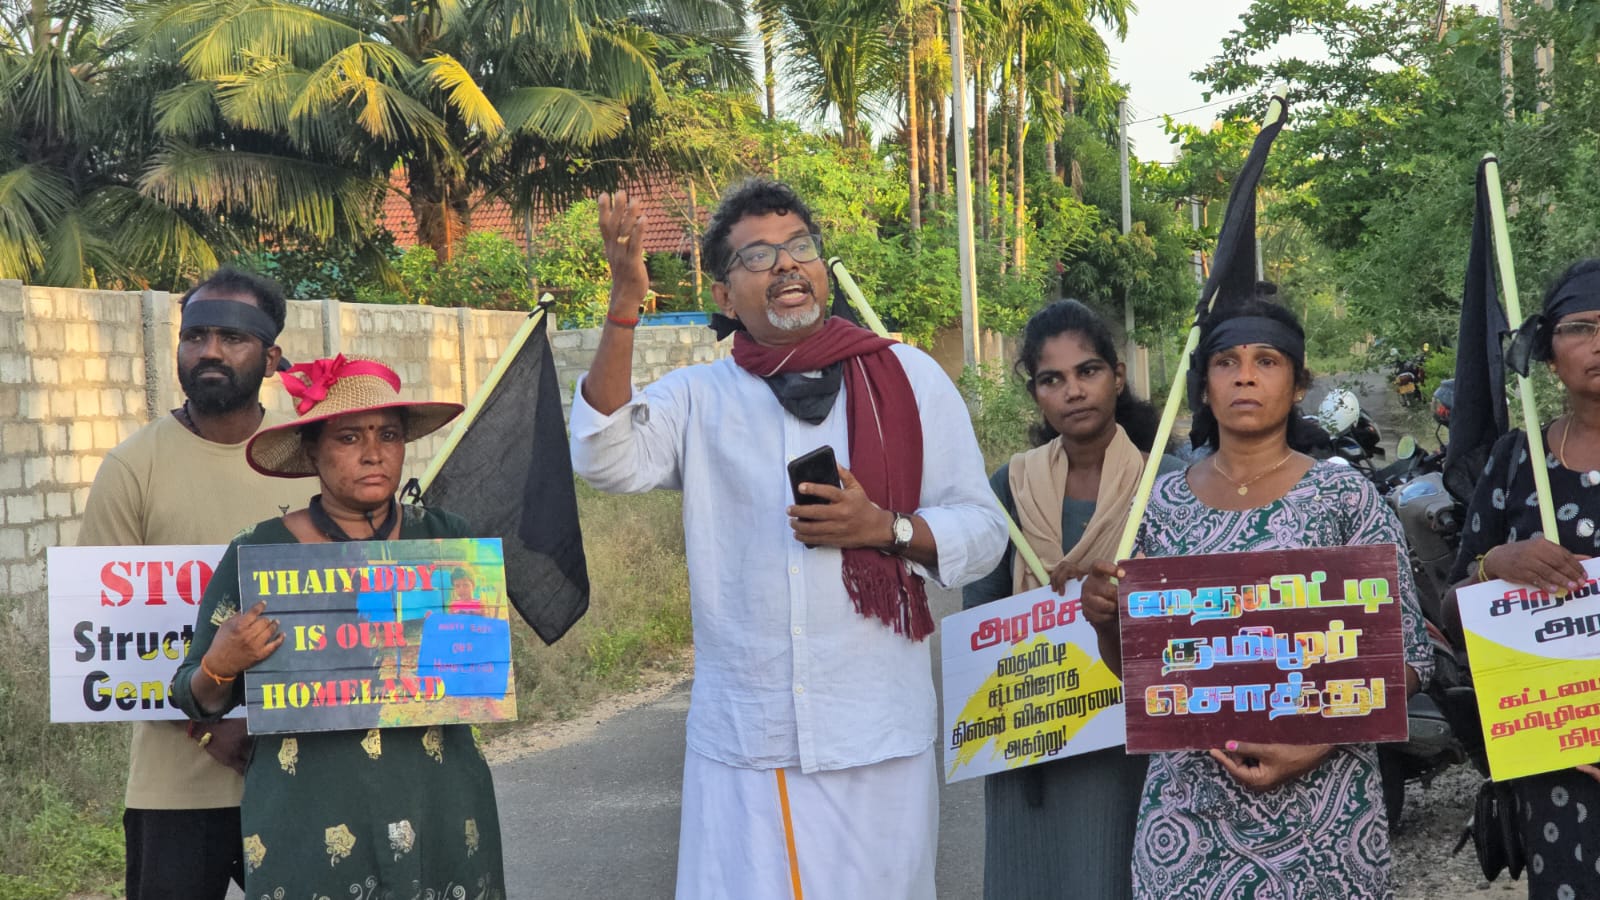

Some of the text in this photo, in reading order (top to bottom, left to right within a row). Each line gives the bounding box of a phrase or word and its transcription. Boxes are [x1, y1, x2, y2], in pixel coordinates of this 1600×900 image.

[100, 560, 217, 607] STO
[253, 564, 437, 596] THAIYIDDY
[1128, 570, 1393, 626] தையிட்டி
[294, 622, 407, 651] IS OUR
[1162, 620, 1363, 676] தமிழர்
[997, 642, 1067, 677] தையிட்டி
[261, 676, 446, 710] HOMELAND
[988, 668, 1080, 709] சட்டவிரோத
[1145, 672, 1386, 720] சொத்து
[1005, 725, 1067, 760] அகற்று!
